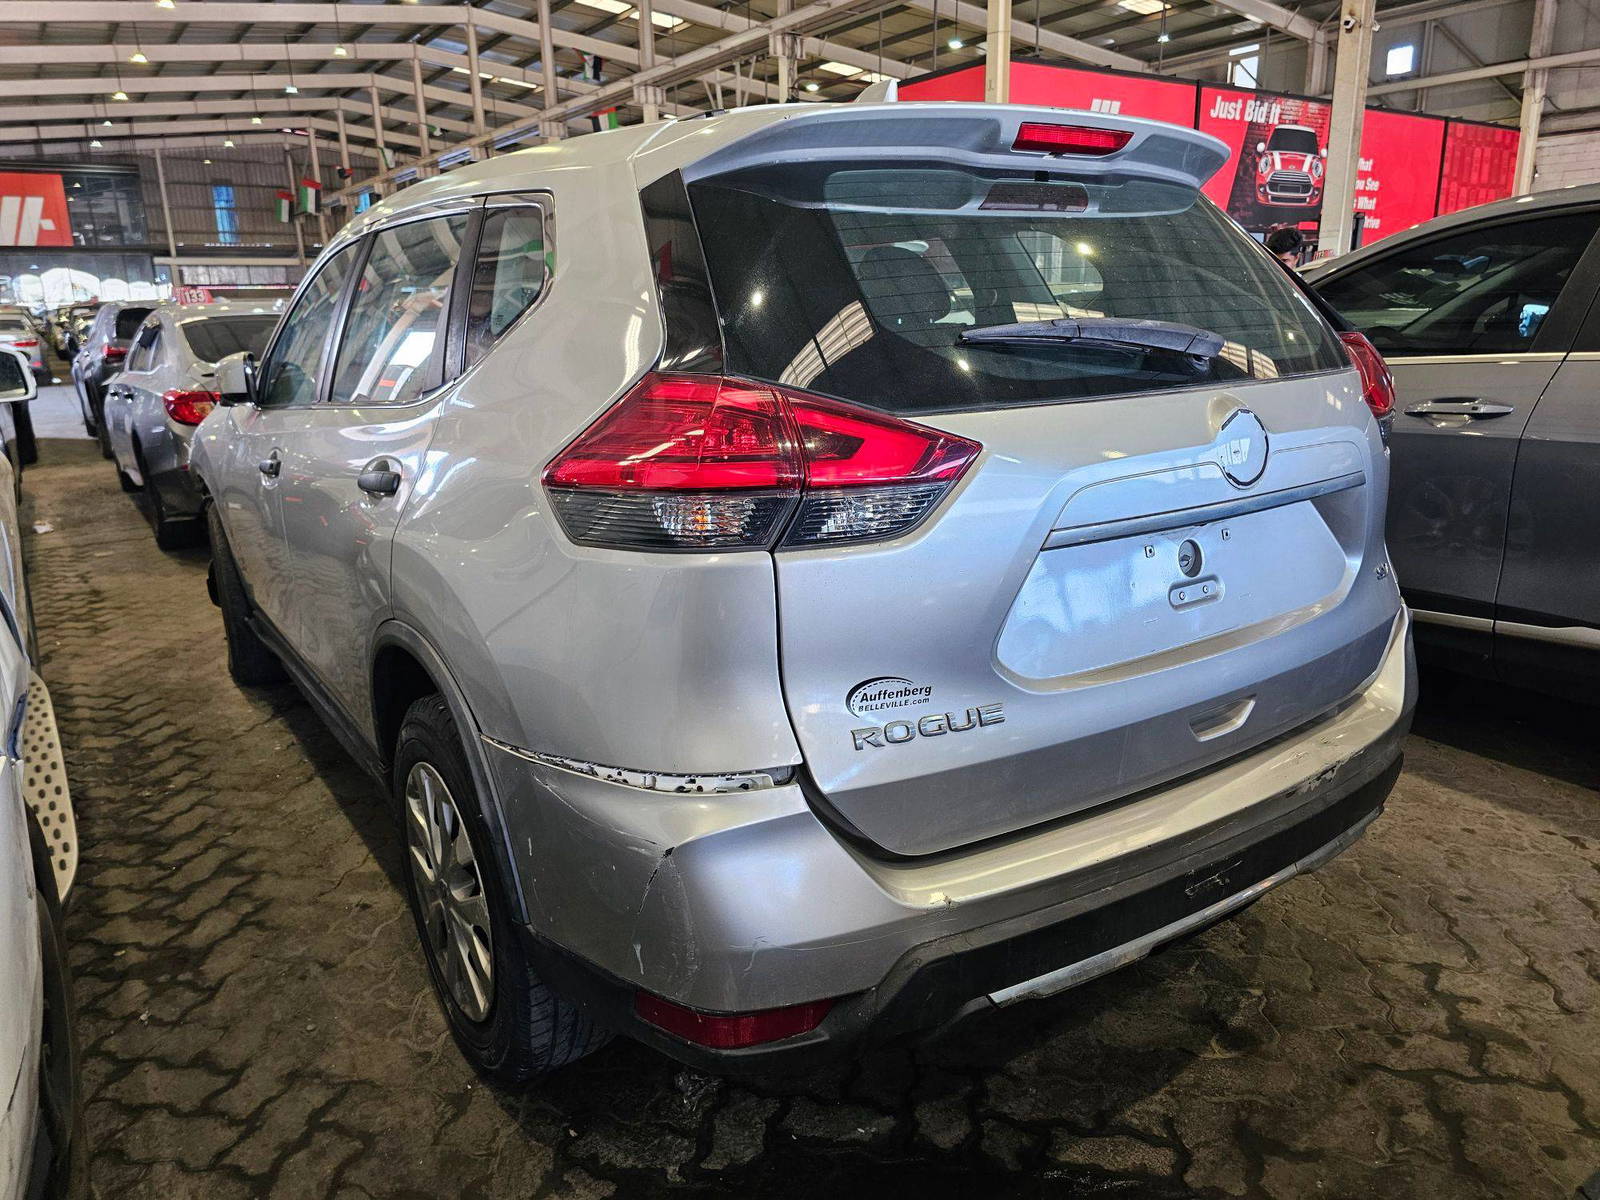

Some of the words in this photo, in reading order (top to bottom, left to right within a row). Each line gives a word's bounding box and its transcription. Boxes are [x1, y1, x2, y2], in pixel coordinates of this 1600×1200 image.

[1210, 96, 1242, 120] Just
[1244, 100, 1268, 124] Bid
[1268, 103, 1280, 125] It
[1355, 179, 1365, 190] ou
[1365, 178, 1380, 191] See
[1357, 196, 1377, 210] What
[1363, 215, 1380, 229] rive
[860, 685, 932, 703] Auffenberg
[858, 698, 930, 712] BELLEVILLE.com
[850, 702, 1006, 751] ROGUE
